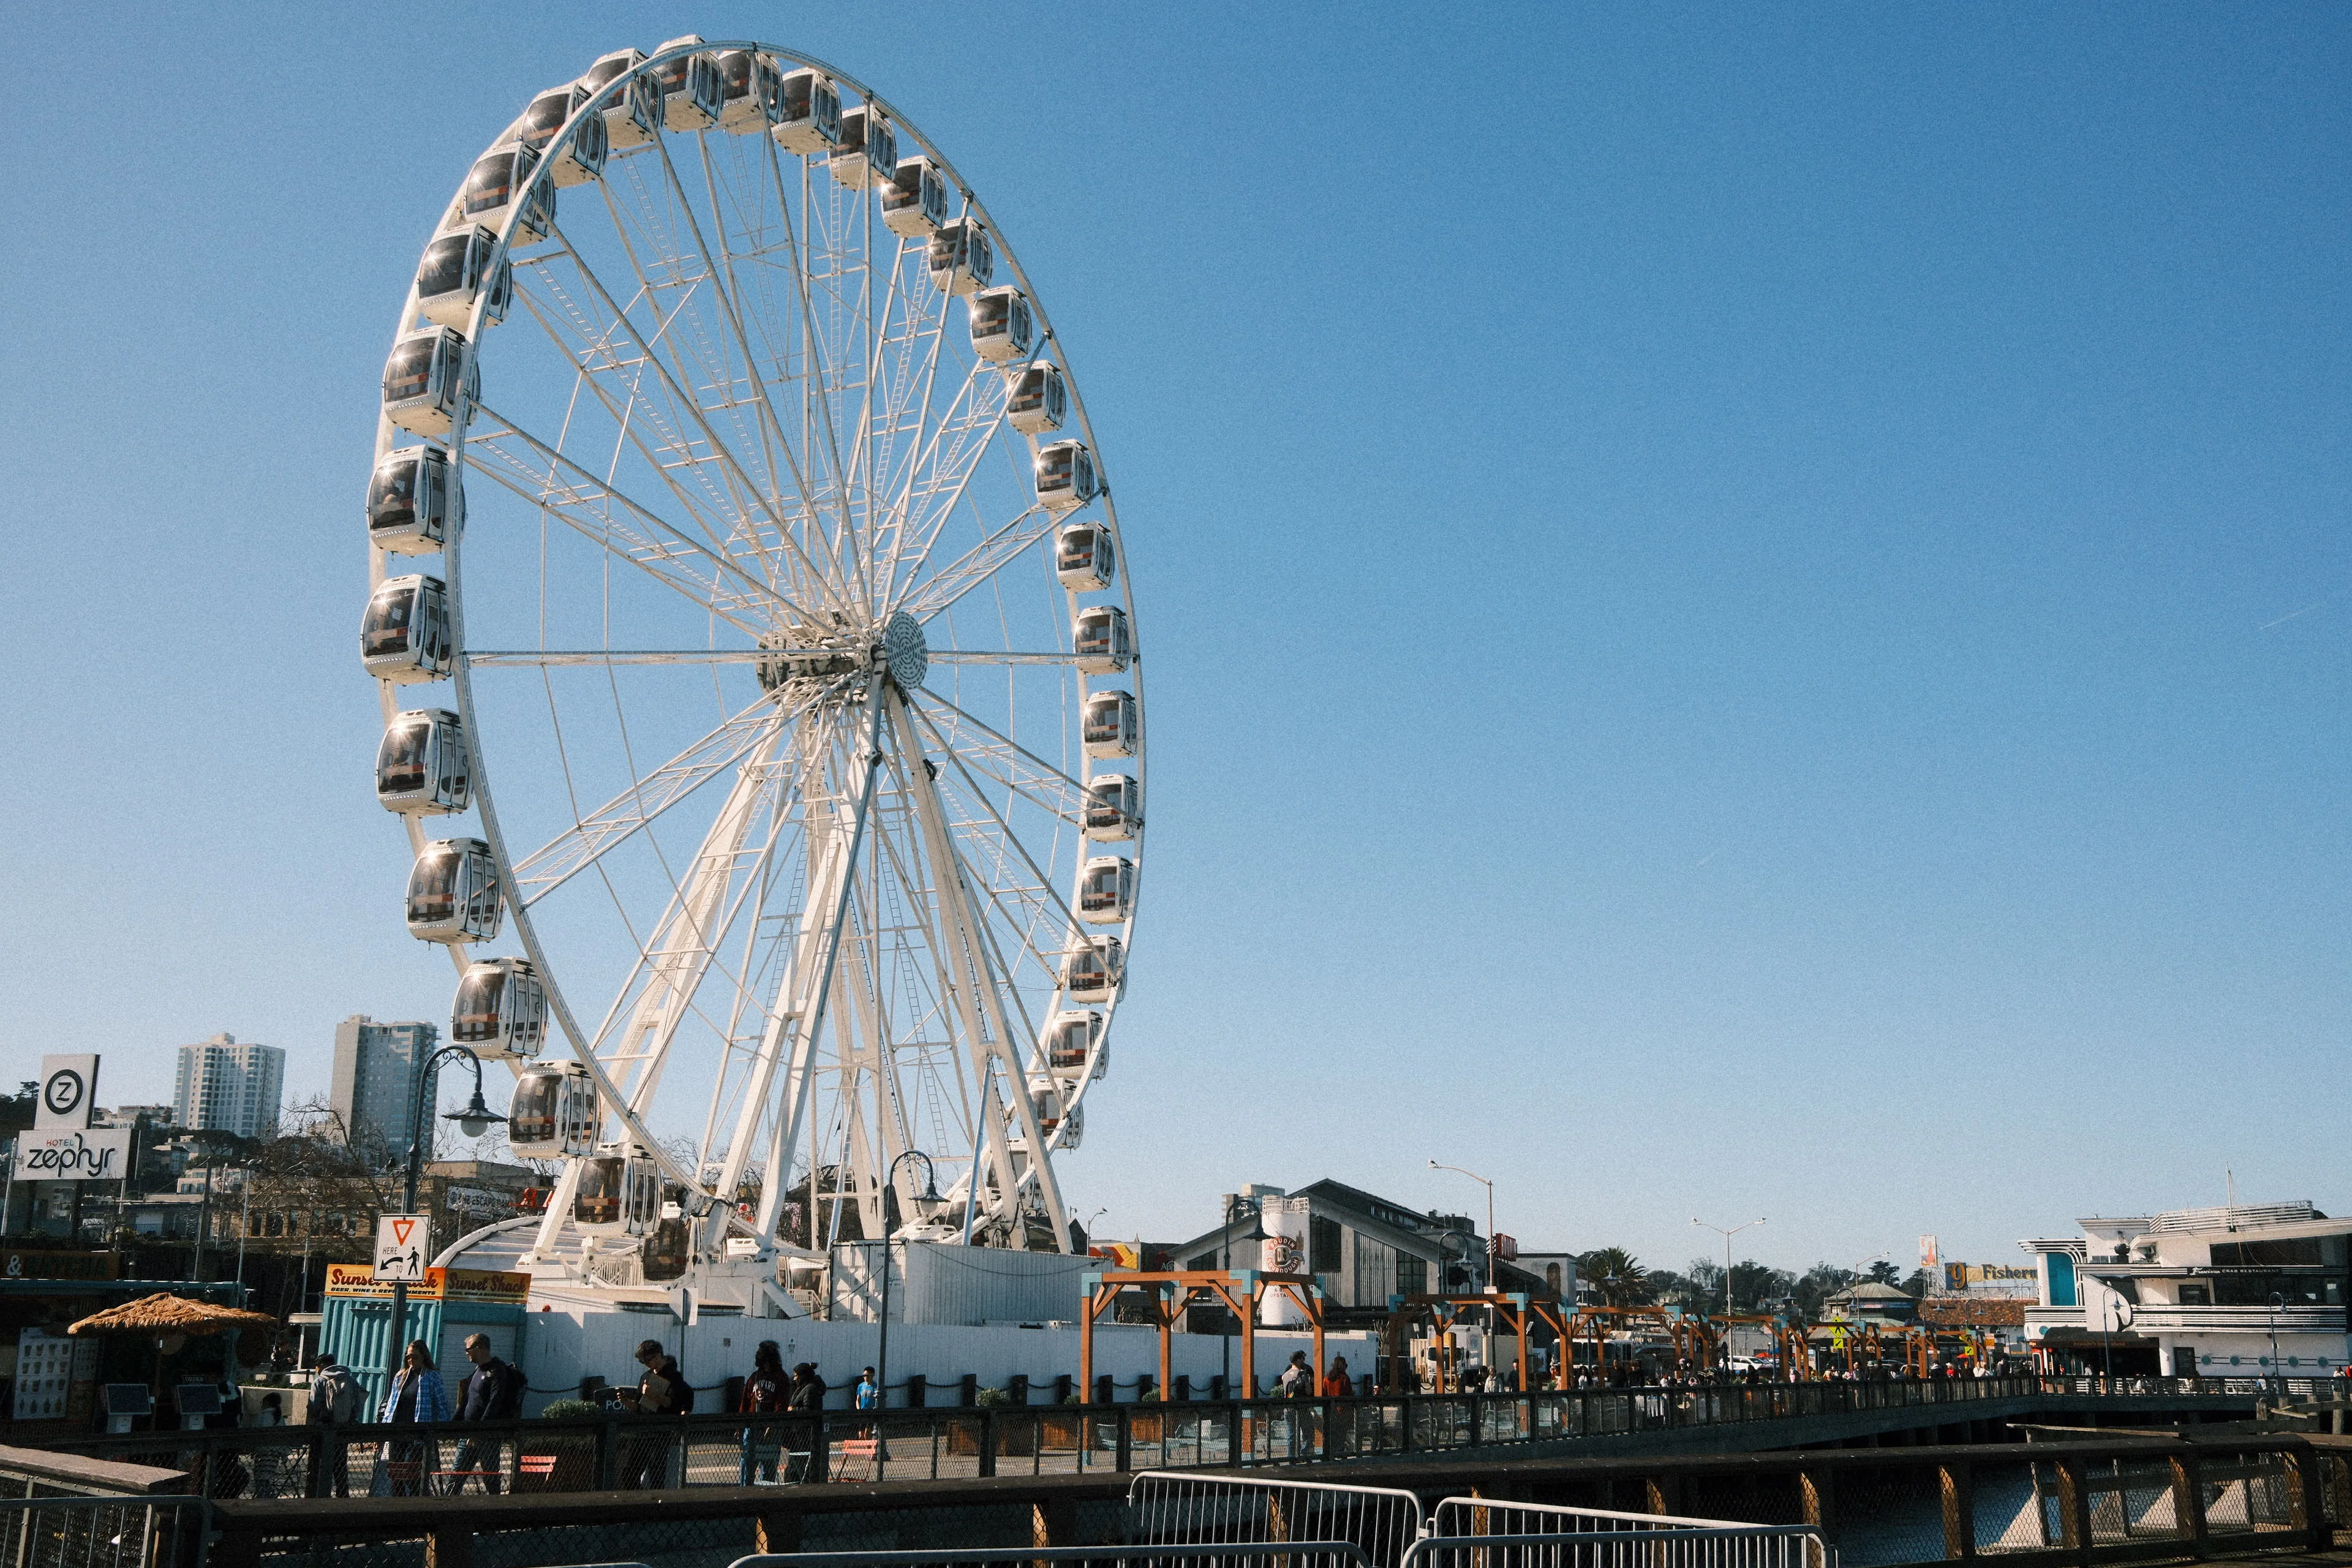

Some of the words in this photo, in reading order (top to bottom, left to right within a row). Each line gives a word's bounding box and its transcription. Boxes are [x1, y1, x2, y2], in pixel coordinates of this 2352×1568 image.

[27, 1133, 115, 1177] zephyr
[1270, 1238, 1295, 1248] BOUDIN
[6, 1254, 22, 1276] &
[396, 1265, 403, 1273] TO
[1268, 1259, 1298, 1273] SOURDOUGH
[331, 1268, 382, 1286] Sunse
[448, 1272, 488, 1291] Sunset
[491, 1274, 527, 1293] Shack
[1951, 1262, 1967, 1289] 9
